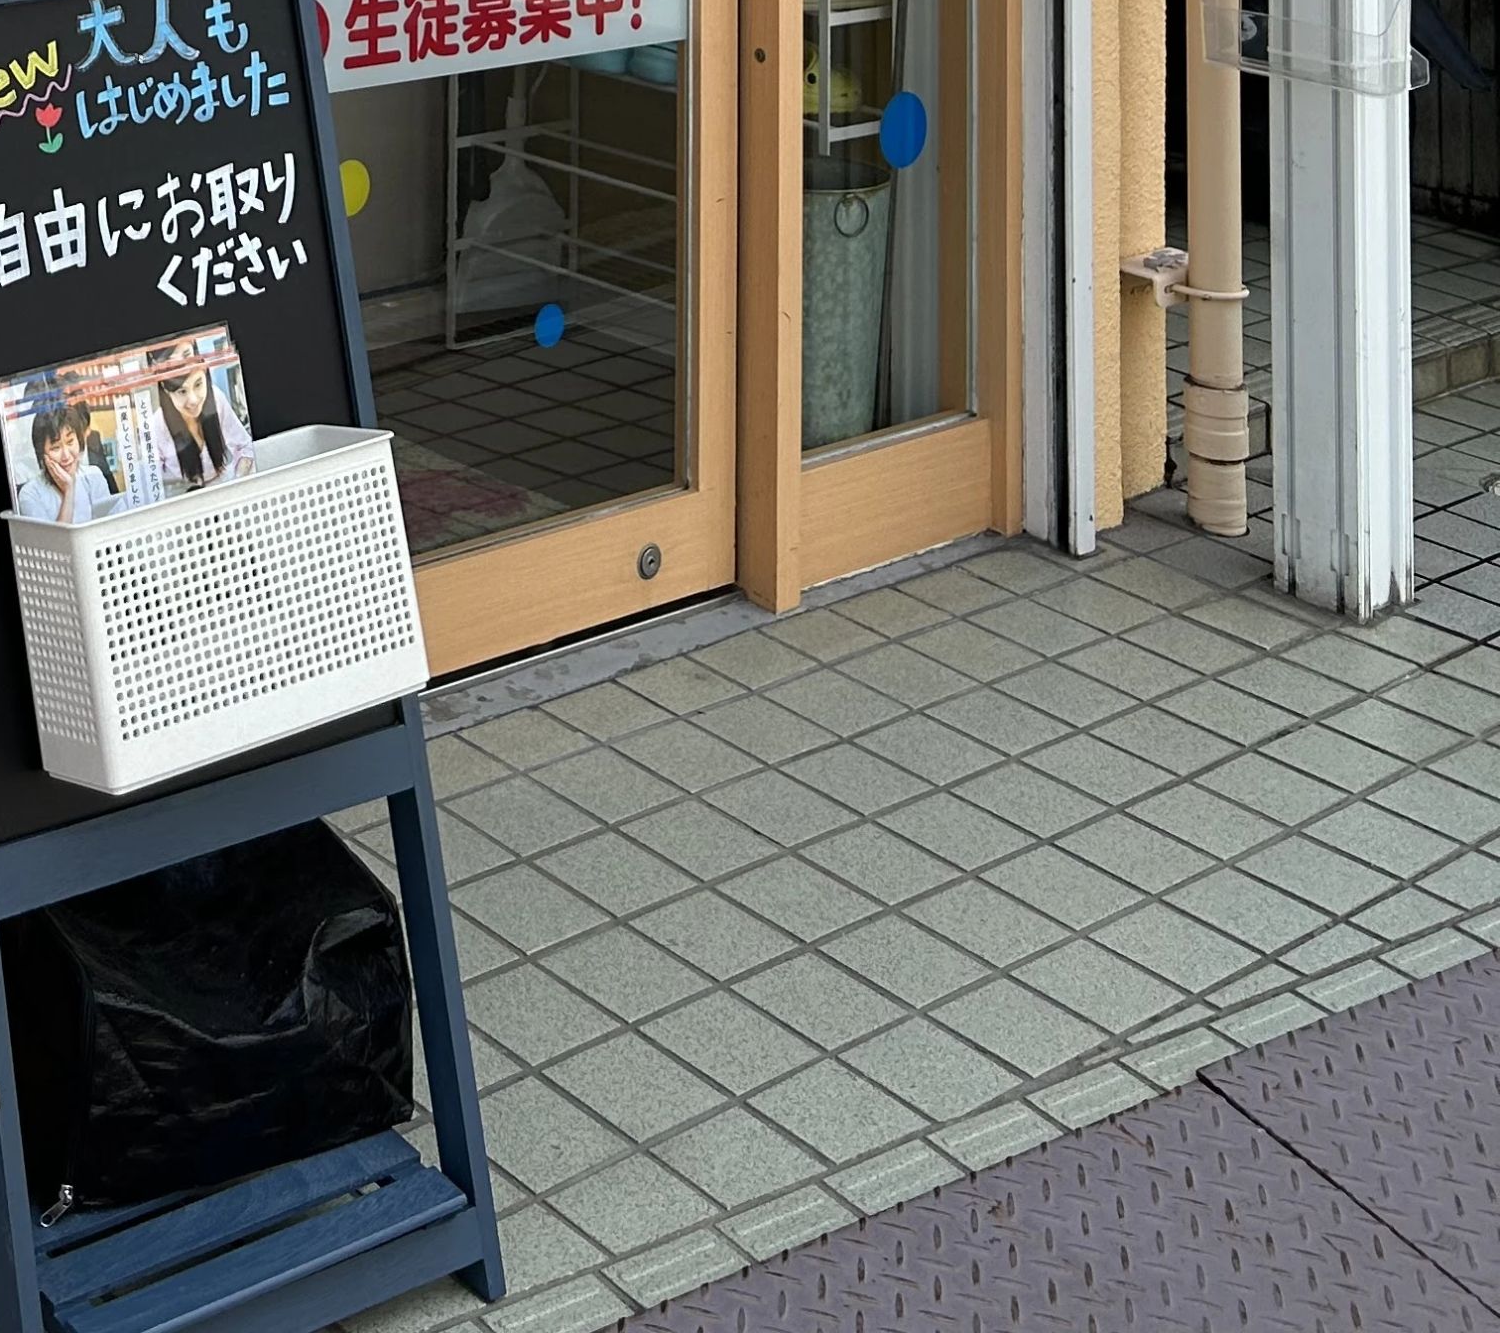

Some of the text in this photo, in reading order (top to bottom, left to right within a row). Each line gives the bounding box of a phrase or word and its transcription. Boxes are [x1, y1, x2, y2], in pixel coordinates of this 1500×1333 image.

[74, 49, 291, 139] はじめました
[156, 231, 309, 309] ください
